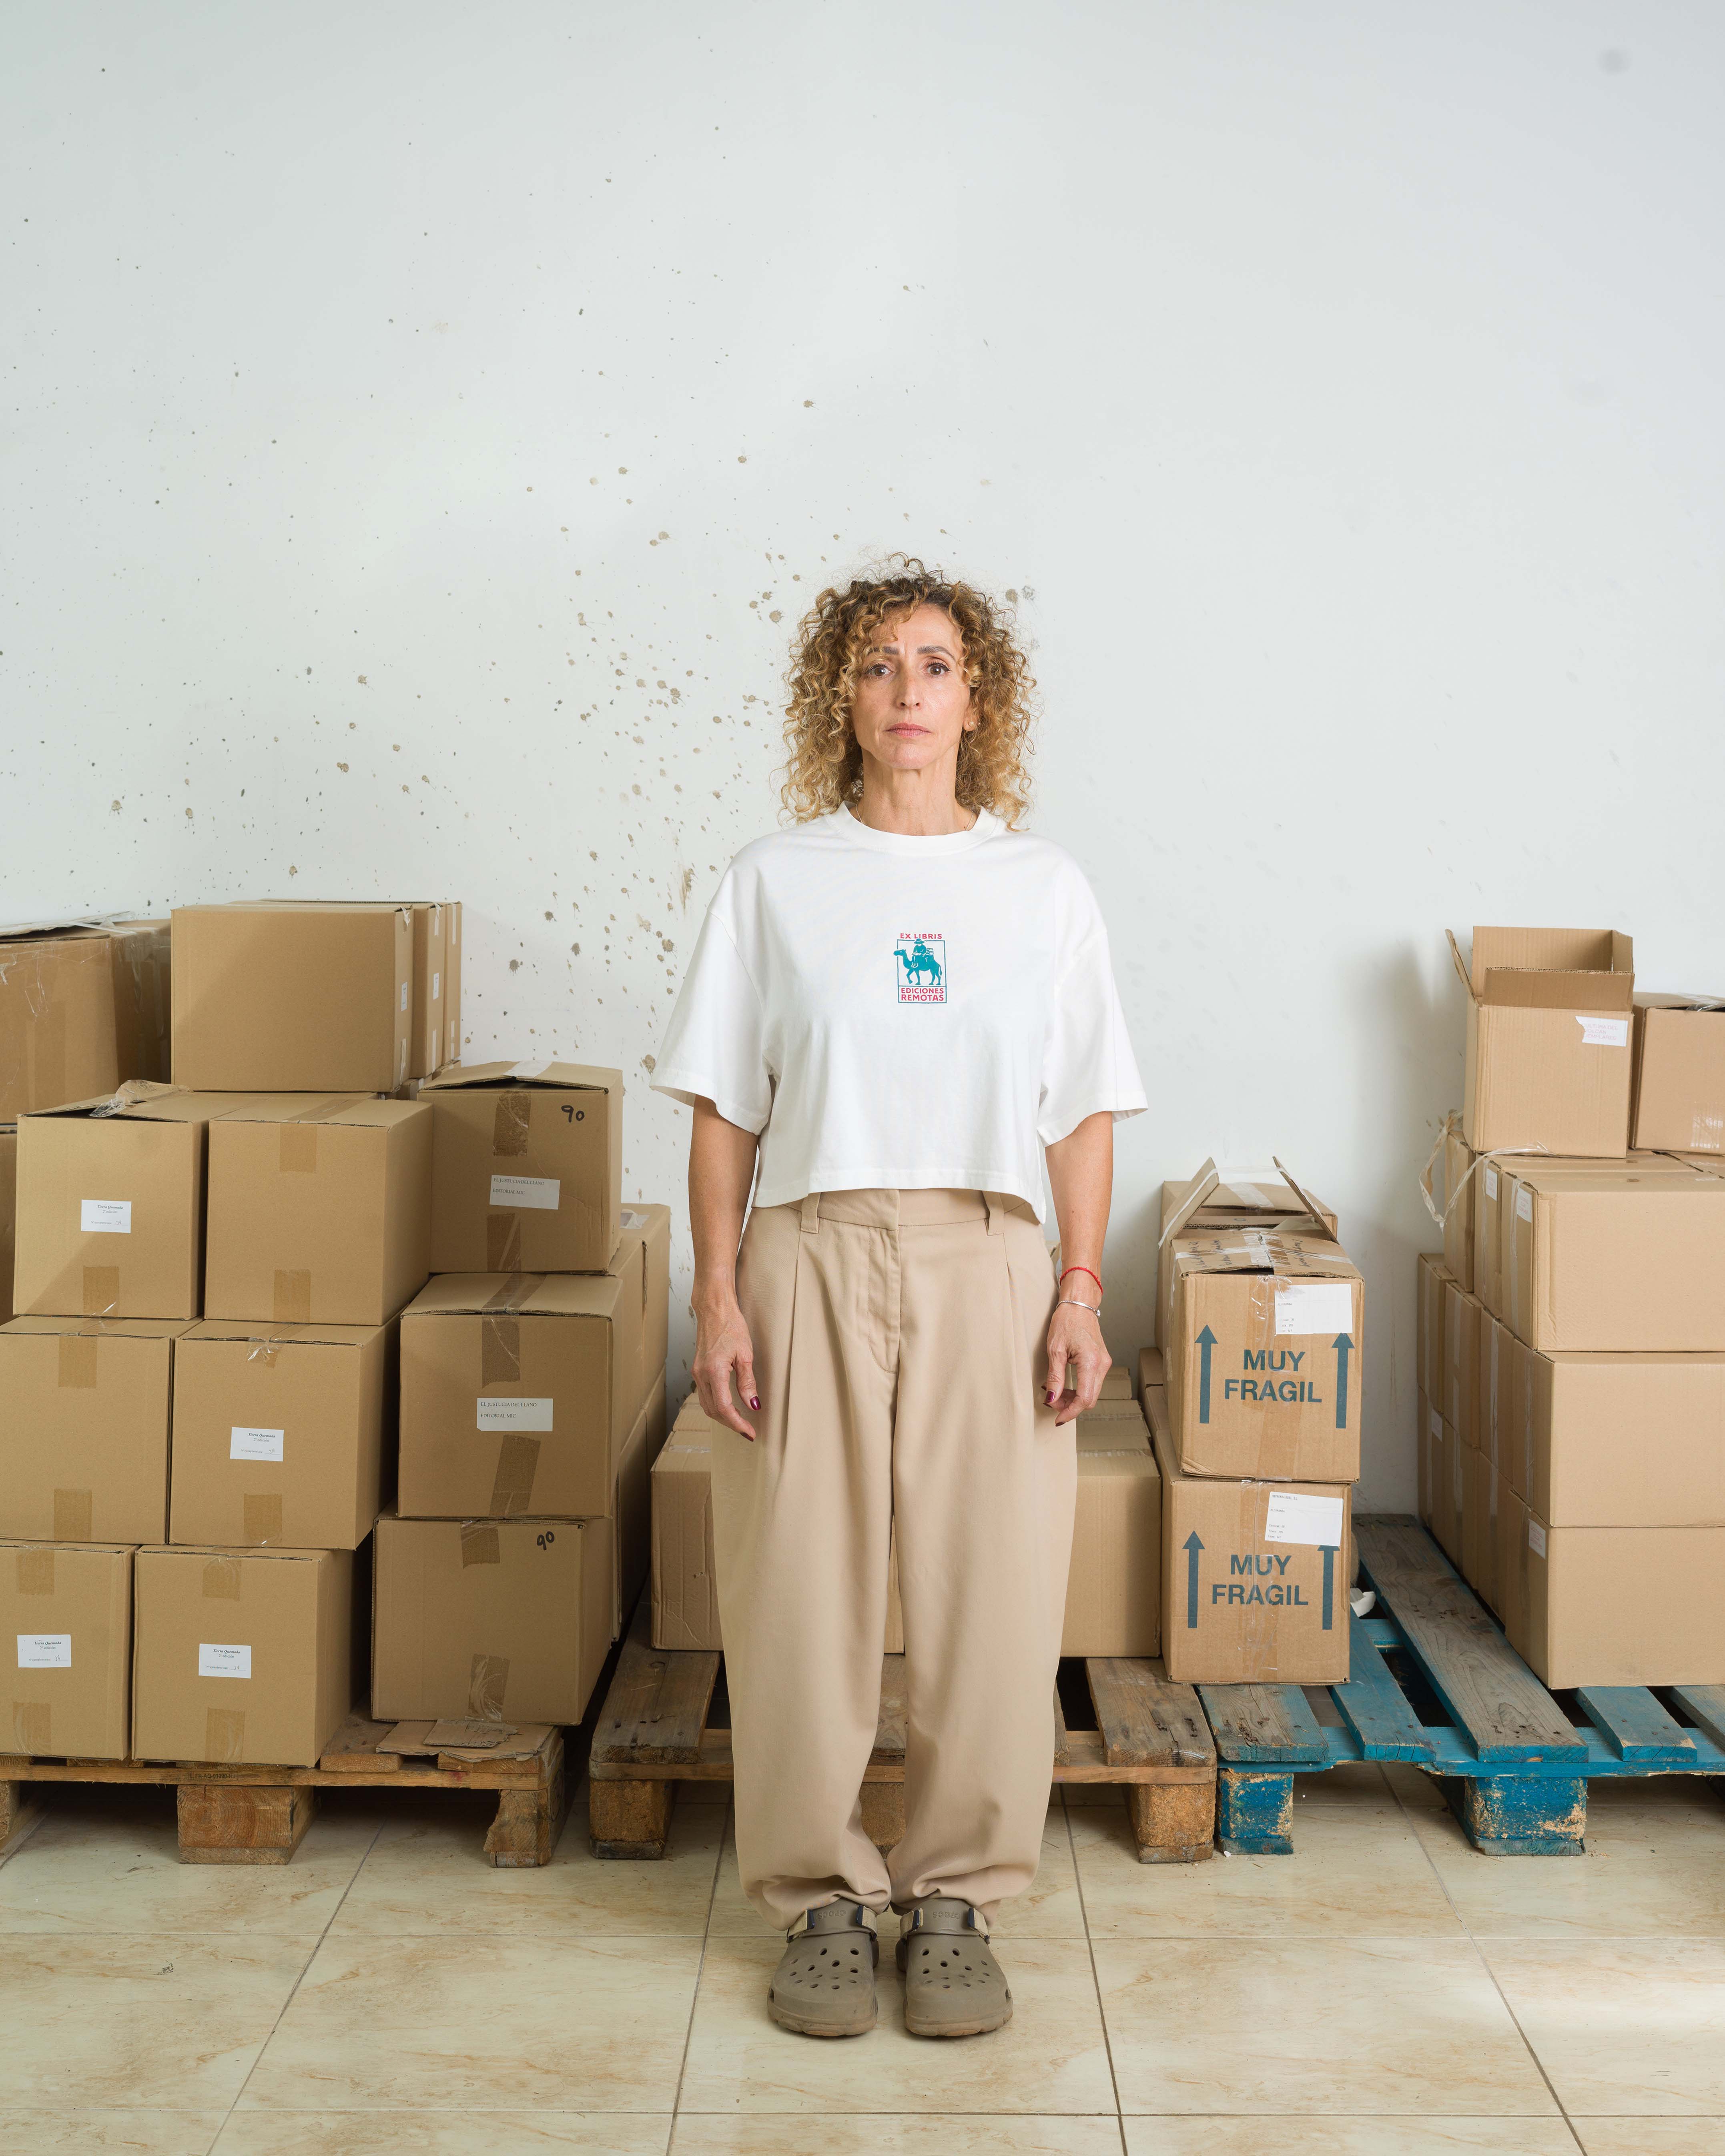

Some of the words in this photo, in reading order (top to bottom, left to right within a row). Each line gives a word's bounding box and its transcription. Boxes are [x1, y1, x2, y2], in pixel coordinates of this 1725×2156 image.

[561, 1105, 585, 1123] 90
[1243, 1349, 1306, 1372] MUY
[1224, 1379, 1322, 1403] FRAGIL
[537, 1531, 555, 1551] 90
[1230, 1554, 1292, 1575] MUY
[1212, 1584, 1309, 1605] FRAGIL
[933, 1911, 961, 1919] crocs
